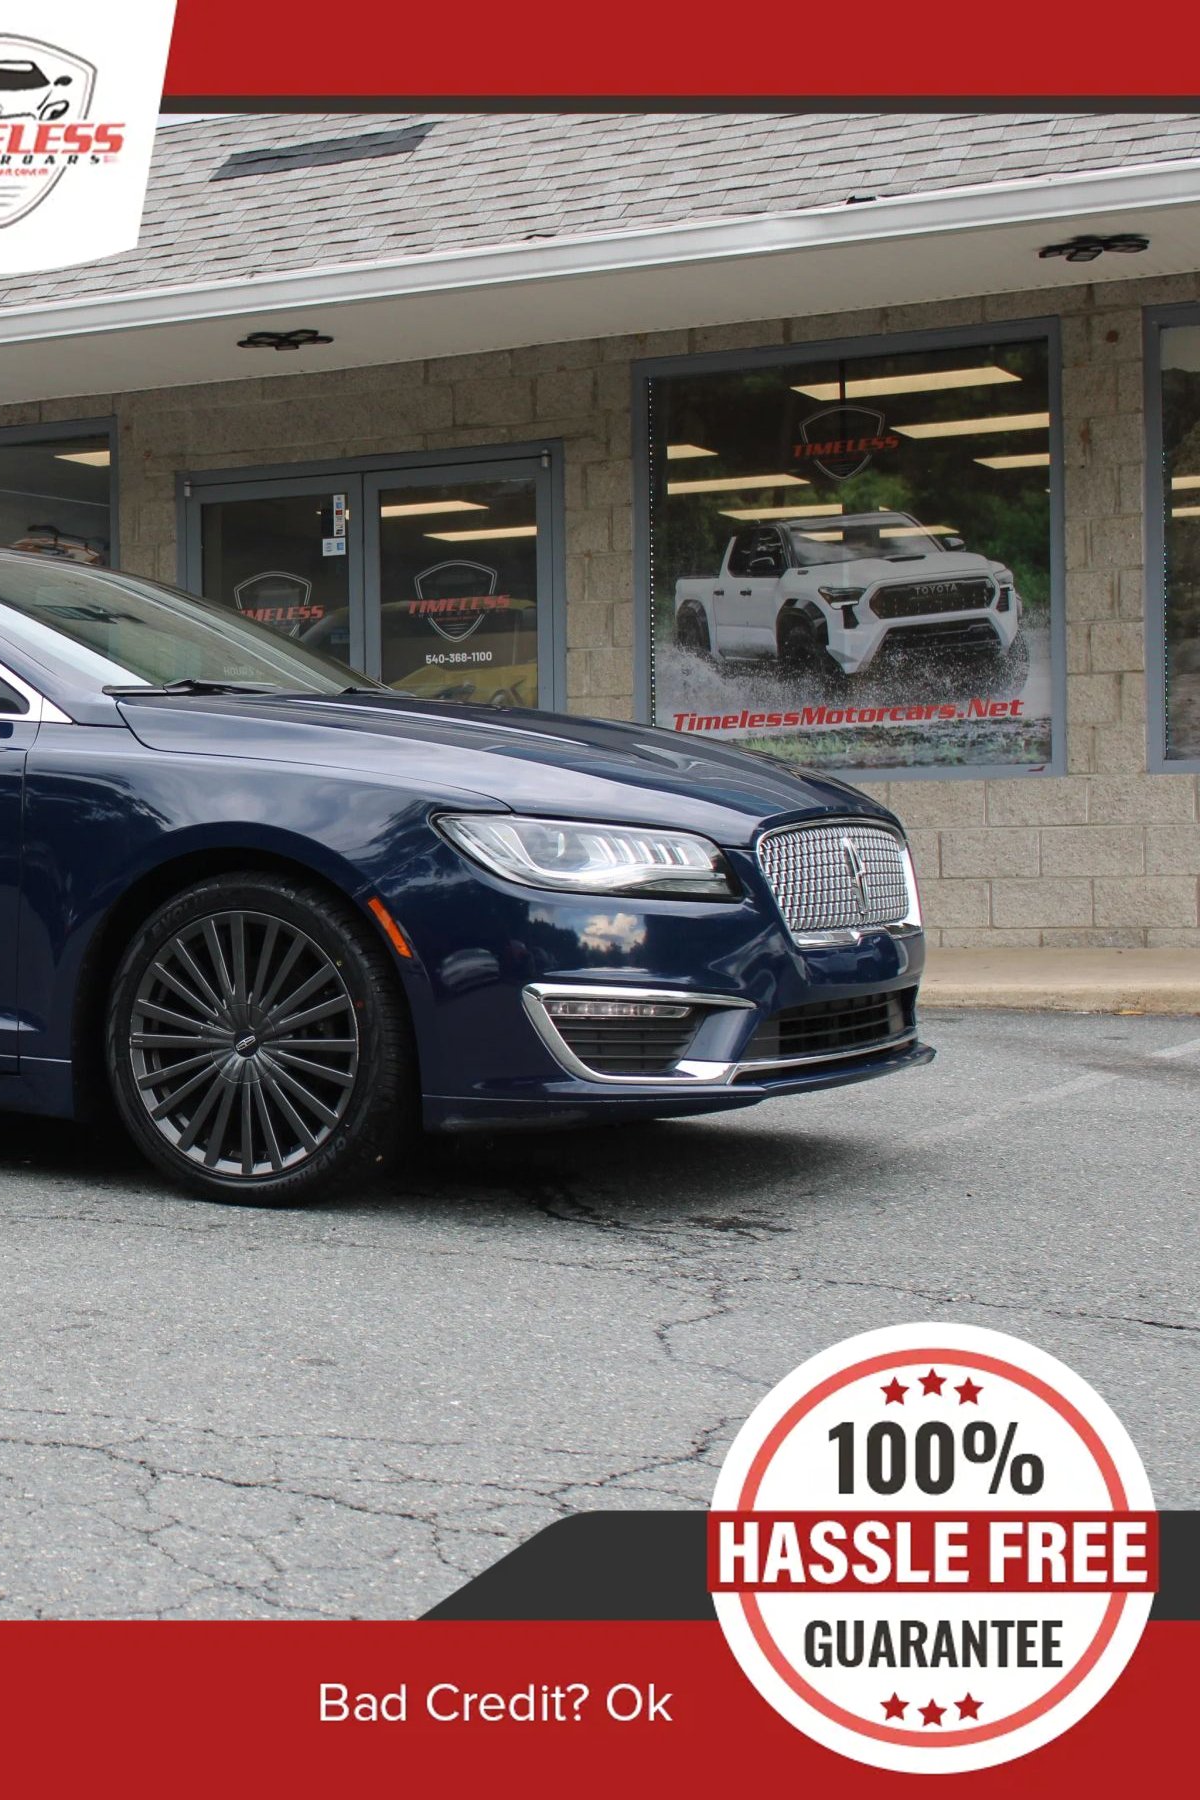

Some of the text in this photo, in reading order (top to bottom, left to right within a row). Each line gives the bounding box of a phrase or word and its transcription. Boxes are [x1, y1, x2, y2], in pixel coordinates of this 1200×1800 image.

[792, 435, 900, 459] TIMELESS
[914, 583, 957, 595] TOYOTA
[408, 594, 511, 615] TIMELESS
[425, 651, 493, 665] 540-368-1100
[673, 698, 1025, 732] TimelessMotorcars.Net
